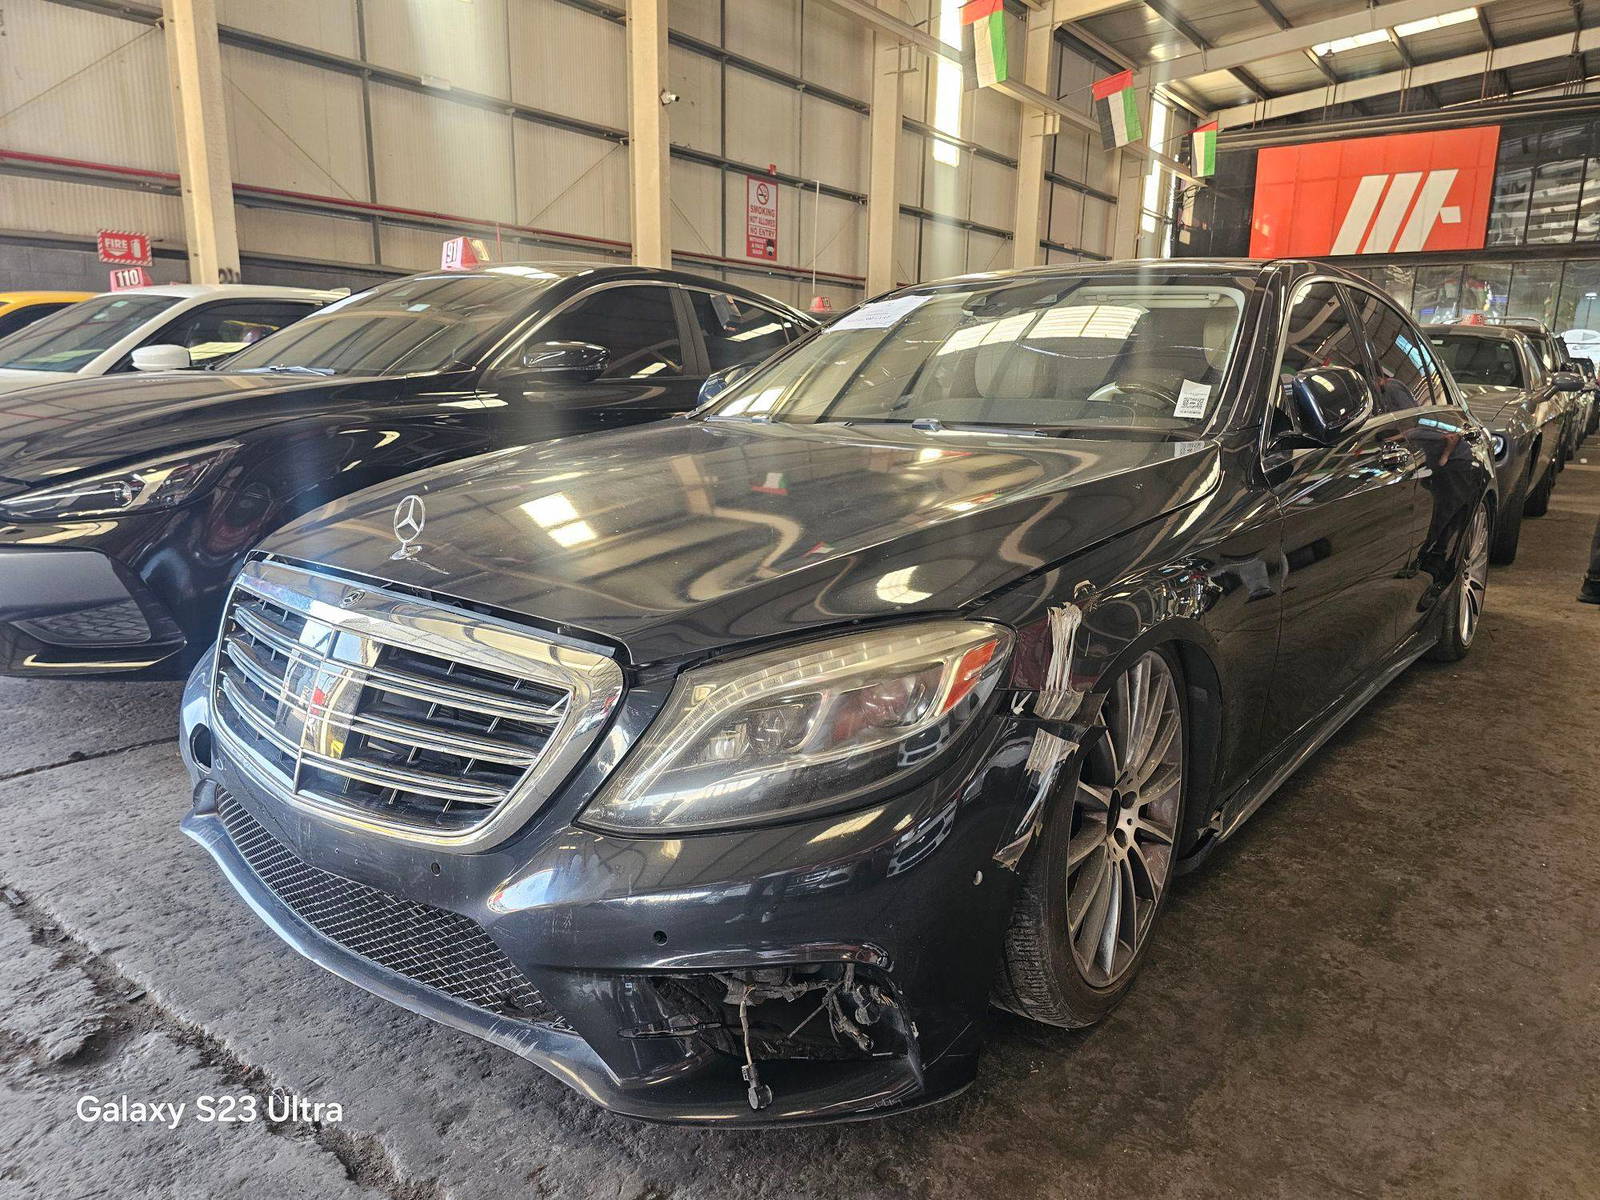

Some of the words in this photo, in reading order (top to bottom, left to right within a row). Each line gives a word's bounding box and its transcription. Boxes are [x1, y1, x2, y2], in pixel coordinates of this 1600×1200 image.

[750, 205, 775, 217] SMOKING
[750, 227, 757, 235] NO
[758, 228, 776, 238] ENTRY
[104, 237, 128, 249] FIRE
[115, 269, 140, 287] 110
